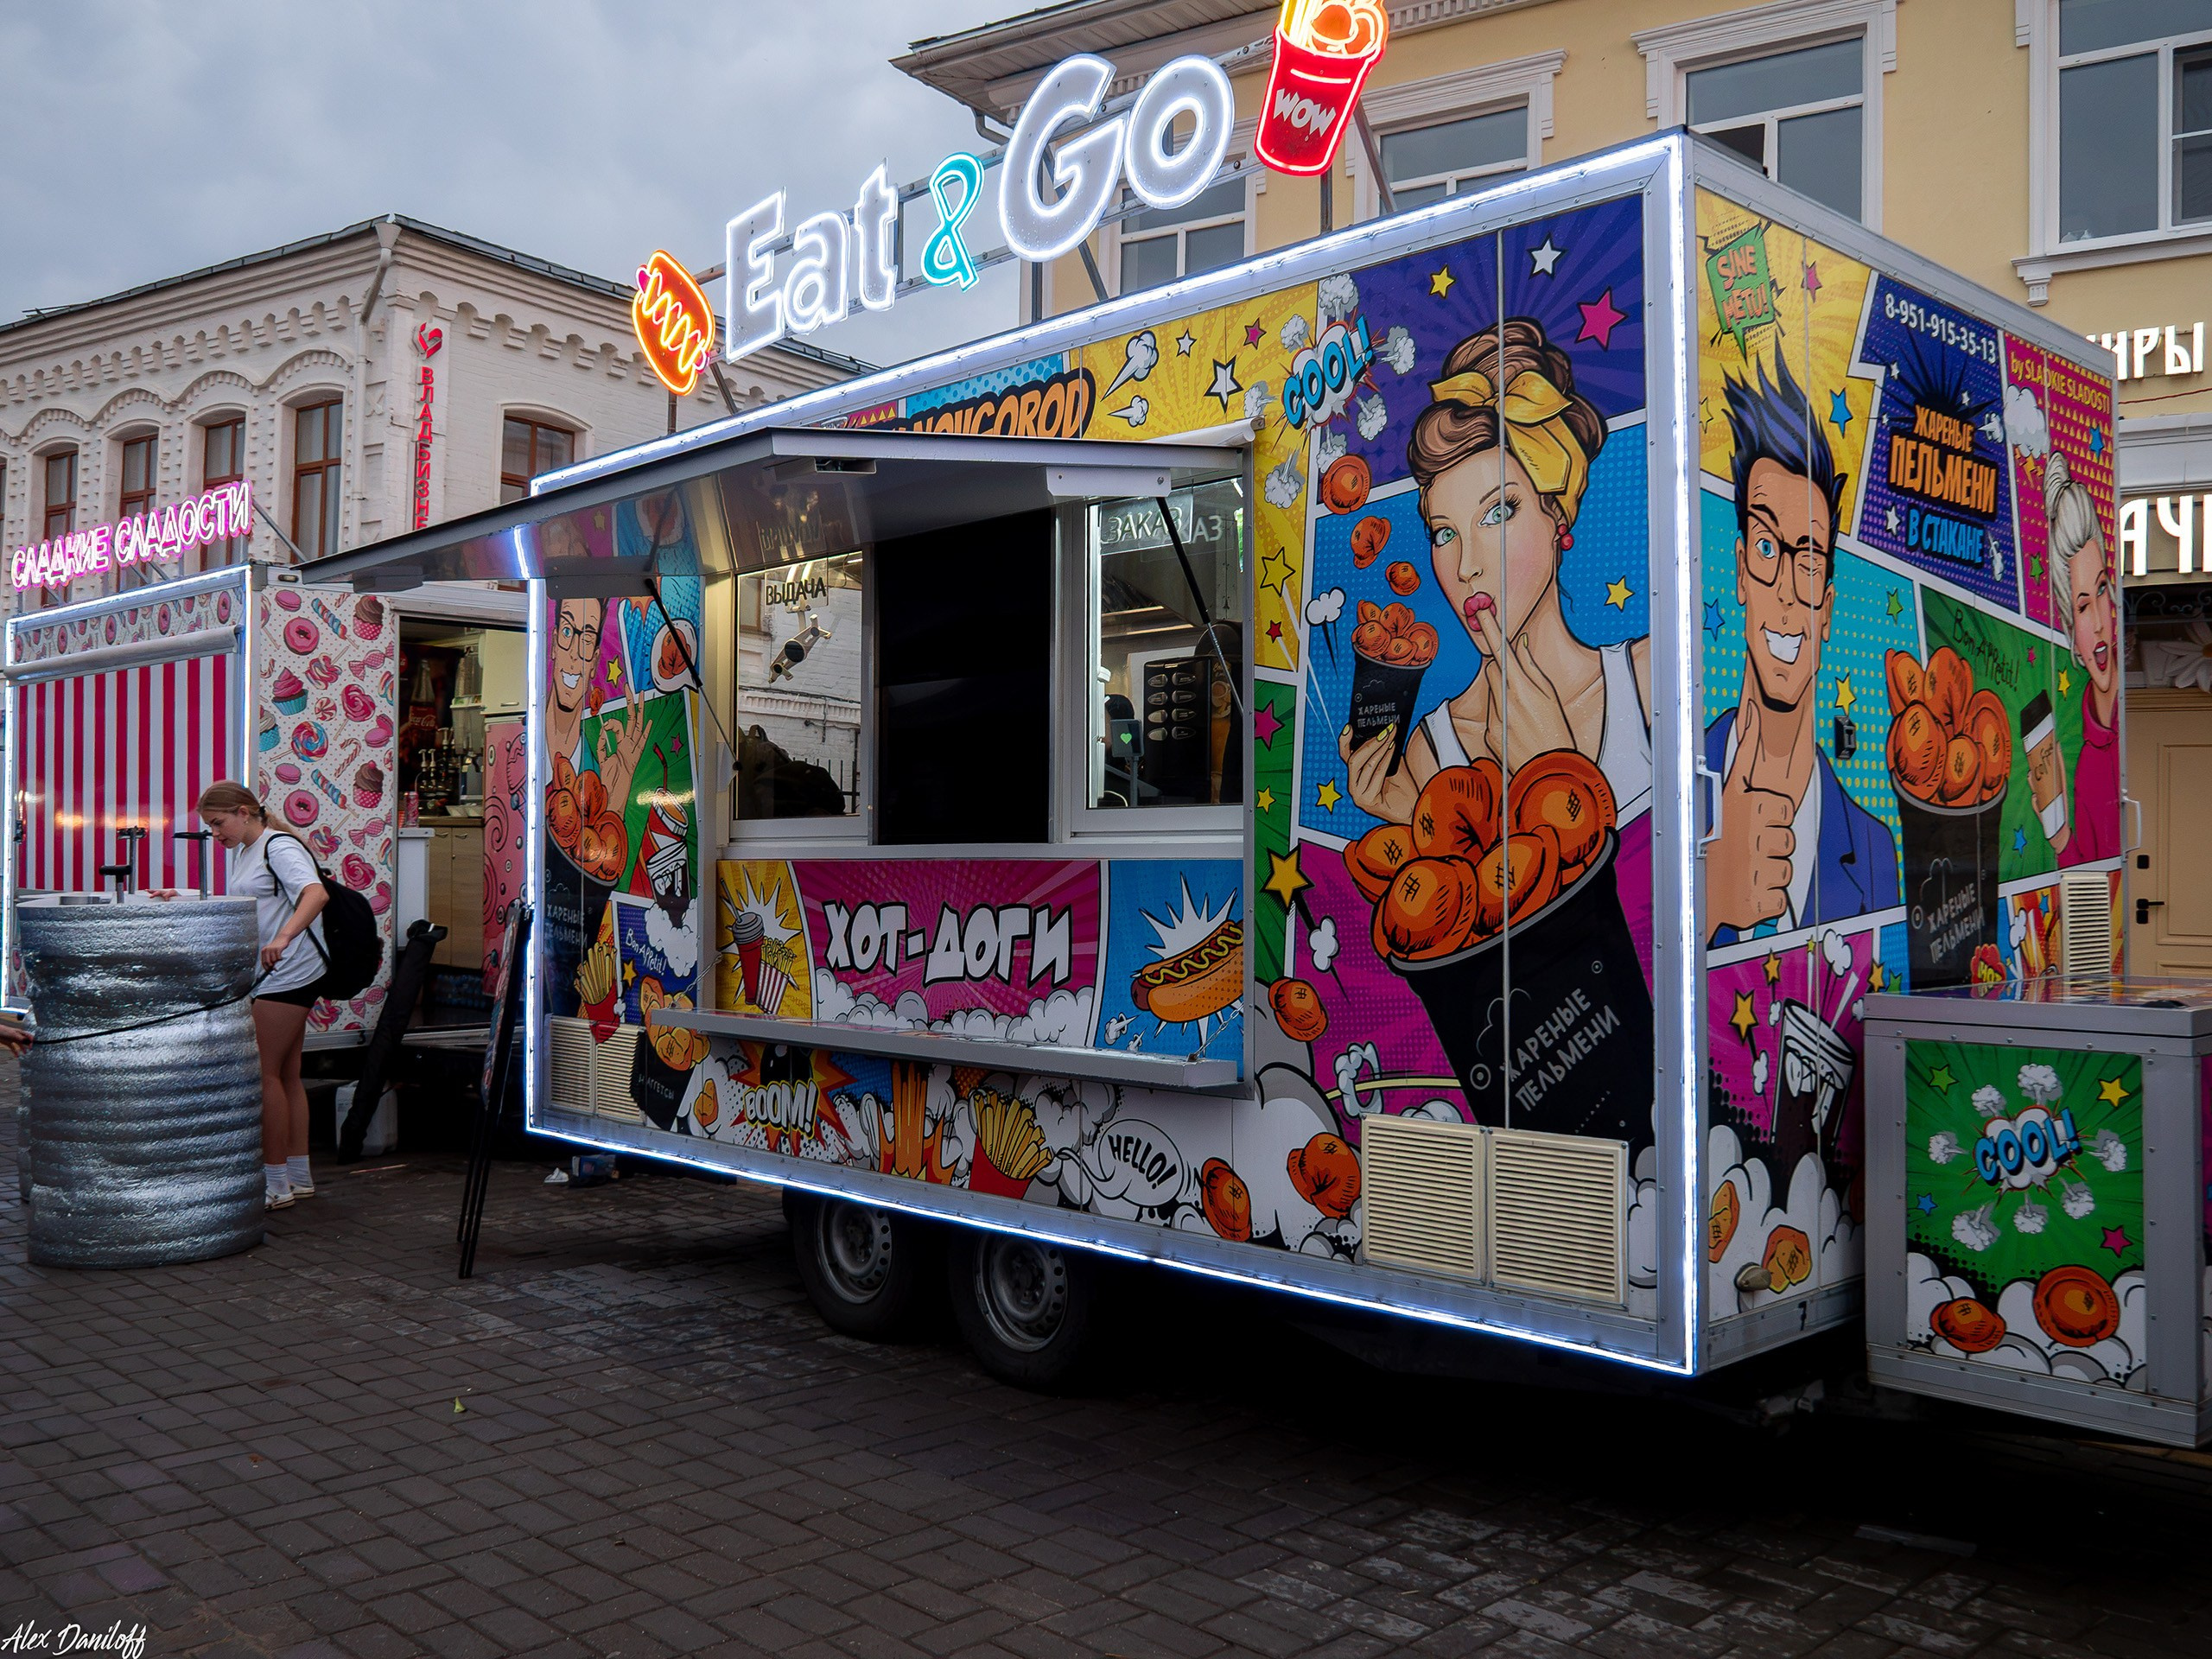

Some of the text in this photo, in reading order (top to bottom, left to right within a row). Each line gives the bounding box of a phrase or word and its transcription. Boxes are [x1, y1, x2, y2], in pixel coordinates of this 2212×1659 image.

[1273, 88, 1337, 137] WOW
[725, 54, 1235, 363] Eat & Go
[1885, 293, 1996, 364] 8-951-915-35-13
[2085, 321, 2204, 381] ИРЫ
[1284, 315, 1376, 429] COOL!
[2010, 351, 2111, 414] by SLADKIE SLADOSTI
[1913, 404, 1974, 452] ЖАРЕНЫЕ
[1890, 435, 1997, 513] ПЕЛЬМЕНИ
[10, 480, 252, 591] СЛАДКИЕ СЛАДОСТИ
[1105, 506, 1183, 544] ЗАКАЗ
[1908, 509, 1983, 563] В СТАКАНЕ
[2119, 493, 2212, 576] АЧ
[766, 576, 827, 607] ВЫДАЧА
[625, 928, 639, 954] Bon
[822, 899, 1074, 989] ХОТ-ДОГИ
[1515, 1005, 1621, 1112] ПЕЛЬМЕНИ
[743, 1081, 820, 1140] BOOM!
[1107, 1134, 1178, 1190] HELLO!
[1974, 1108, 2083, 1186] COOL!
